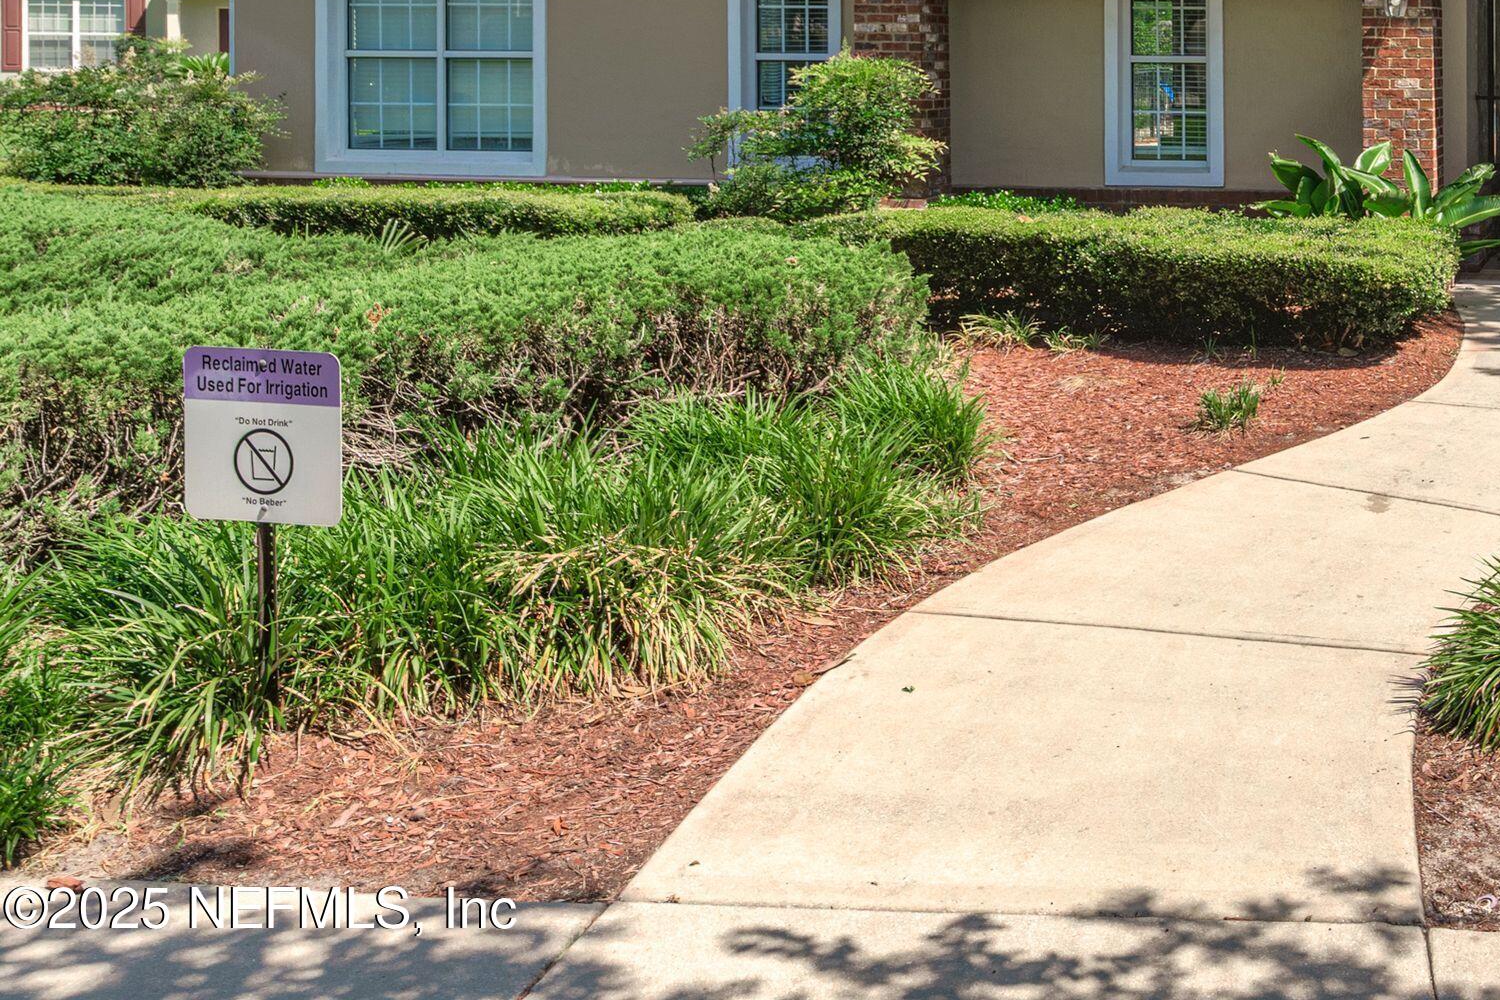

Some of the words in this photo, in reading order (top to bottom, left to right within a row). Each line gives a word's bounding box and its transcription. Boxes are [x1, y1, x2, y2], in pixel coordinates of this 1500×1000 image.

[202, 355, 276, 373] Reclaimed
[281, 358, 322, 376] Water
[197, 376, 234, 393] Used
[238, 378, 261, 394] For
[266, 379, 328, 399] Irrigation
[252, 418, 265, 426] Not
